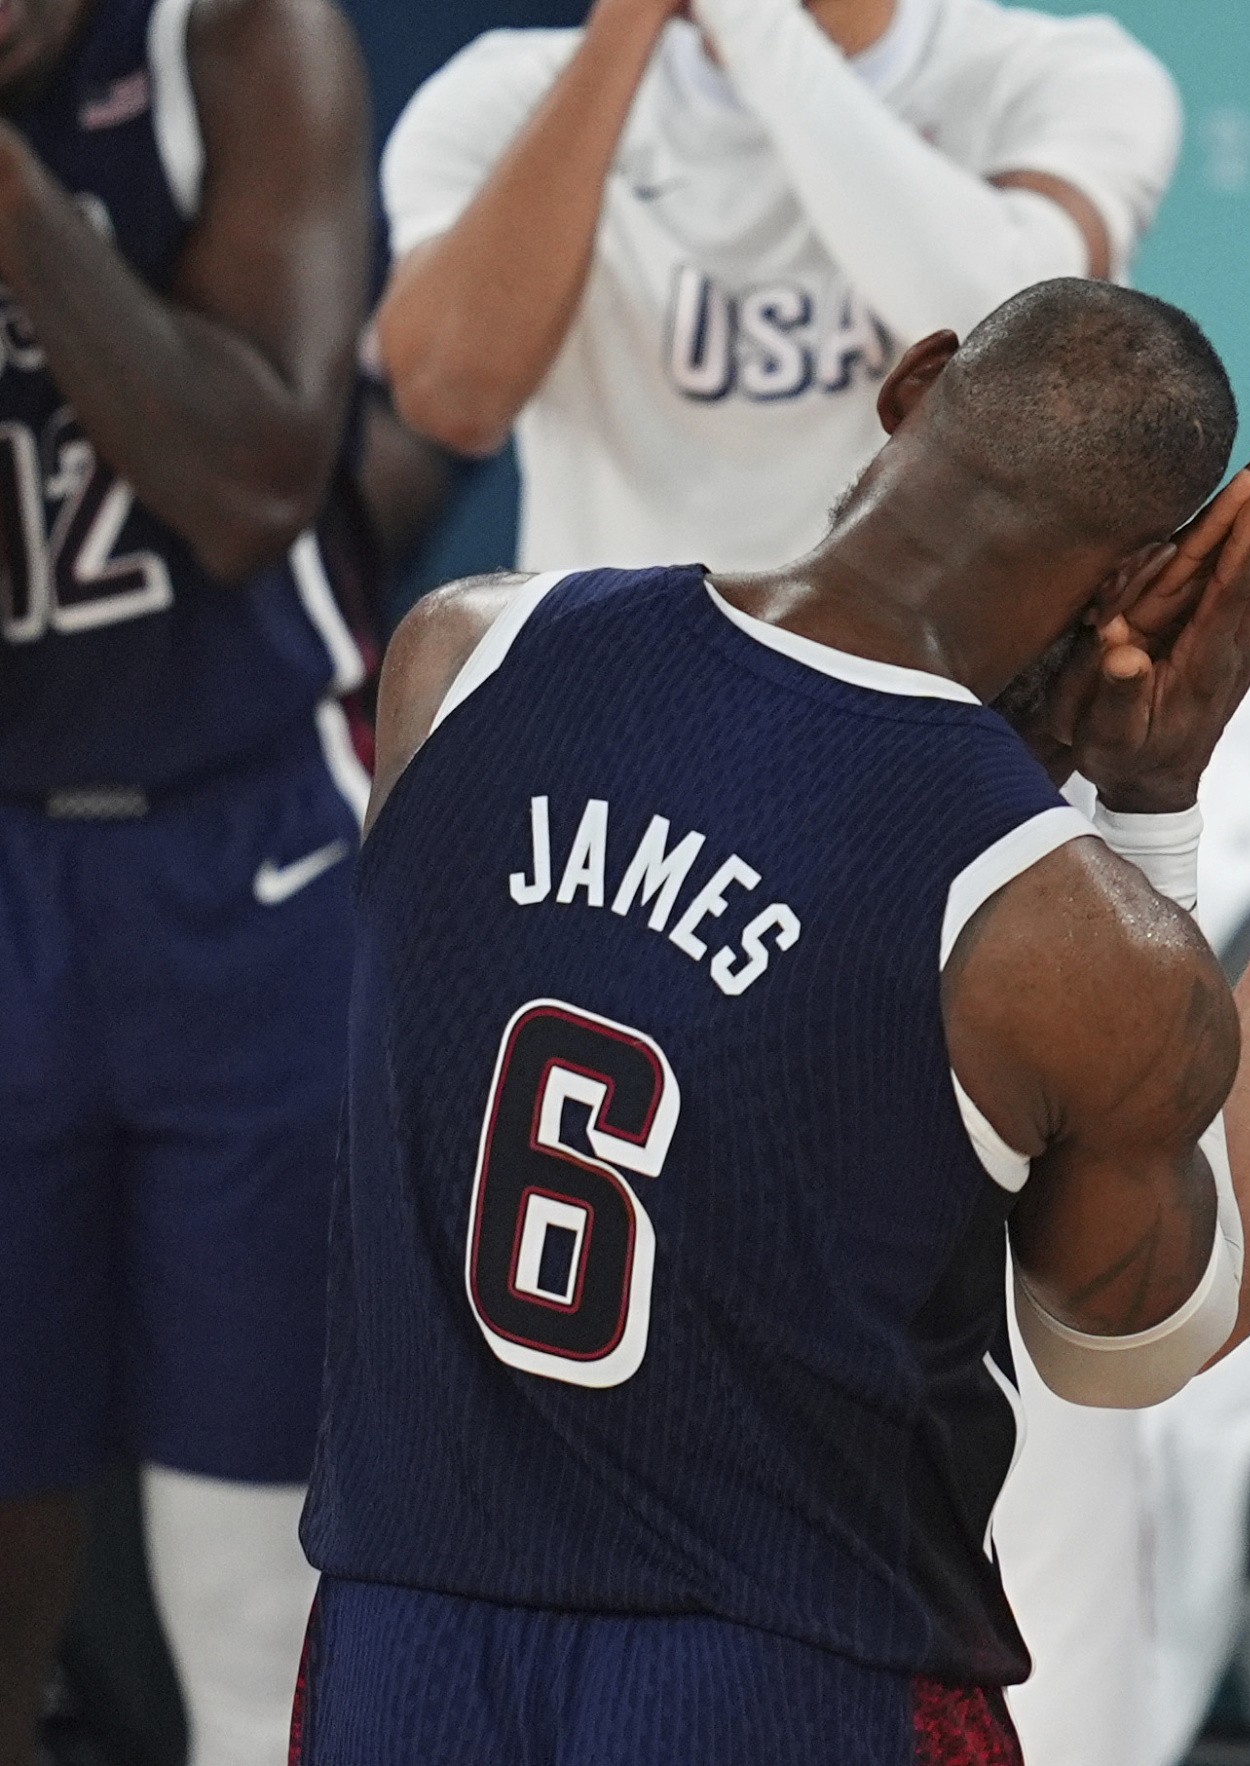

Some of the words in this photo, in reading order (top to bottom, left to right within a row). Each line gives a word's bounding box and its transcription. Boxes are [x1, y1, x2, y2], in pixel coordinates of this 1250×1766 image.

[664, 262, 898, 402] USA
[509, 795, 801, 996] JAMES
[465, 997, 681, 1389] 6
